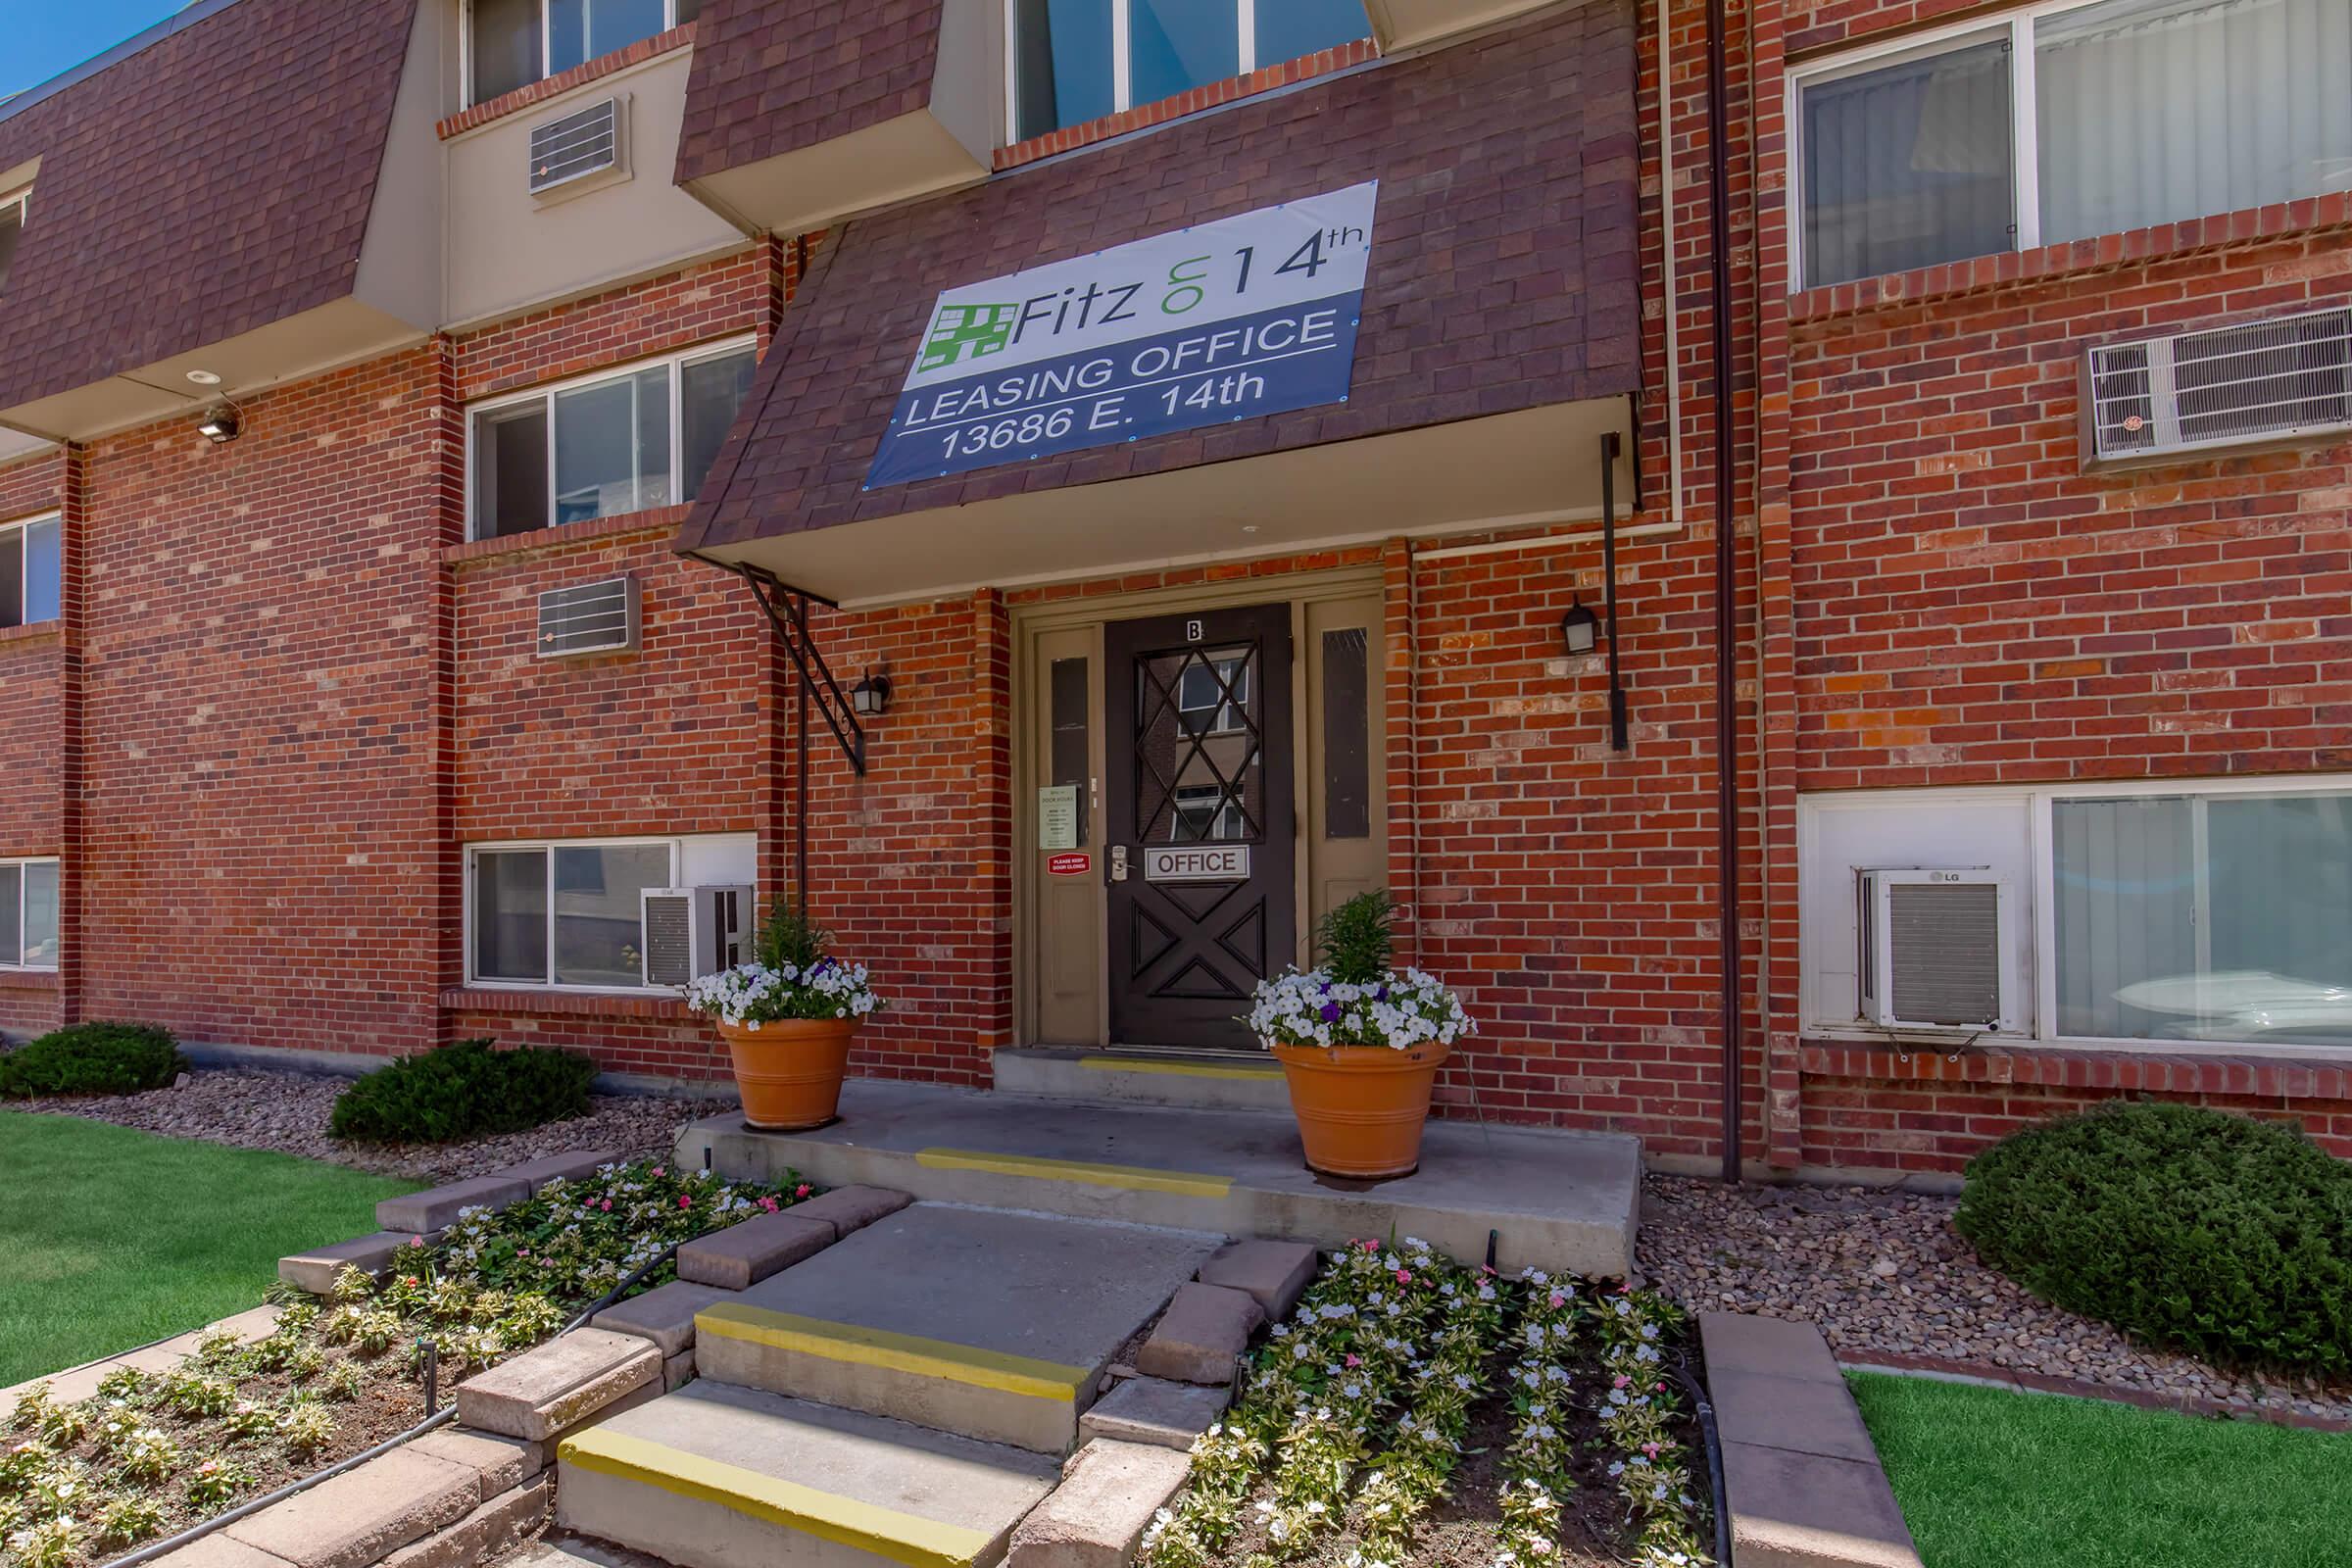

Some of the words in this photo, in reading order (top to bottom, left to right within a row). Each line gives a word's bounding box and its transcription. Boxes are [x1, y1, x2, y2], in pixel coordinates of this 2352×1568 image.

[1011, 281, 1145, 345] Fitz
[904, 358, 1114, 427] LEASING
[1130, 309, 1338, 377] OFFICE
[941, 407, 1074, 460] 13686
[1088, 398, 1135, 430] E.
[1159, 371, 1265, 416] 14th
[1189, 622, 1200, 639] B
[1157, 852, 1237, 873] OFFICE
